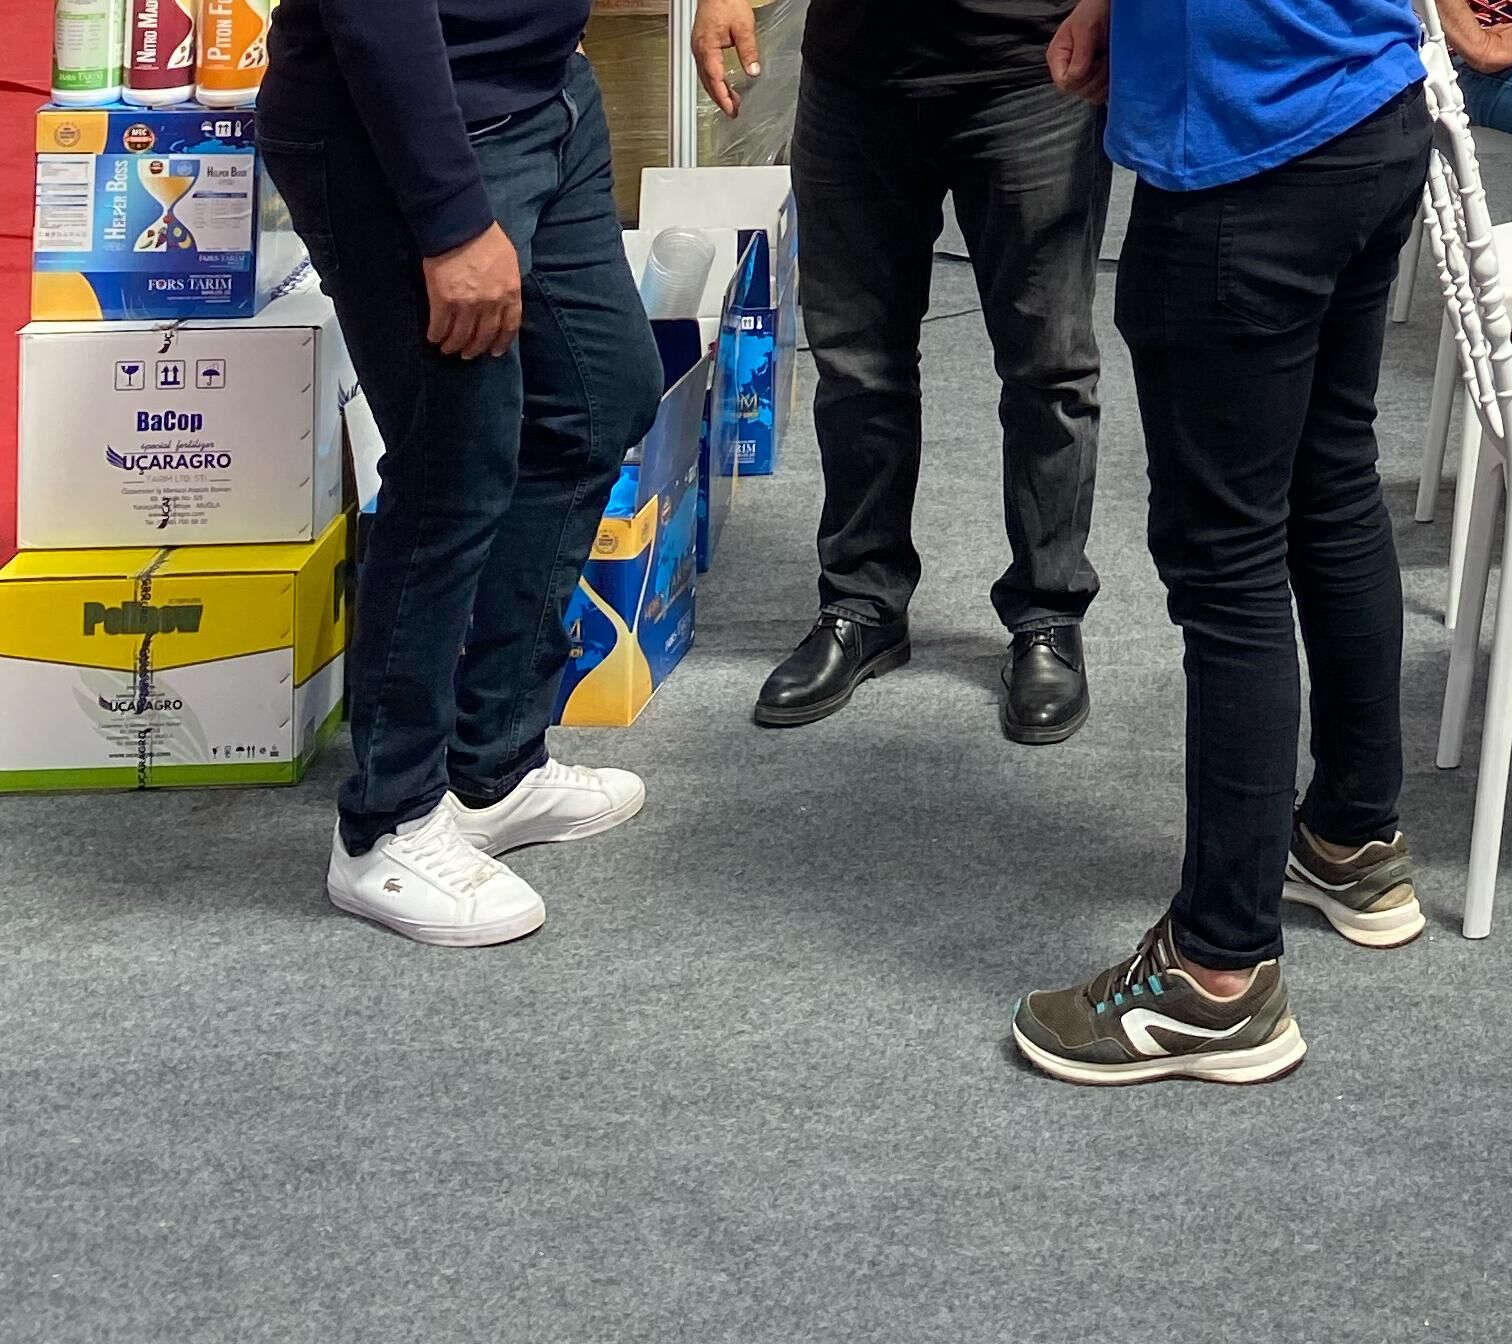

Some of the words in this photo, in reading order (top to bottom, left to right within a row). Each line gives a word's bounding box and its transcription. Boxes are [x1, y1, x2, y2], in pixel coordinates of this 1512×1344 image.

[148, 278, 185, 291] FORS
[188, 278, 232, 291] TARIM
[136, 410, 203, 433] BaCop
[123, 453, 232, 475] UÇARAGRO
